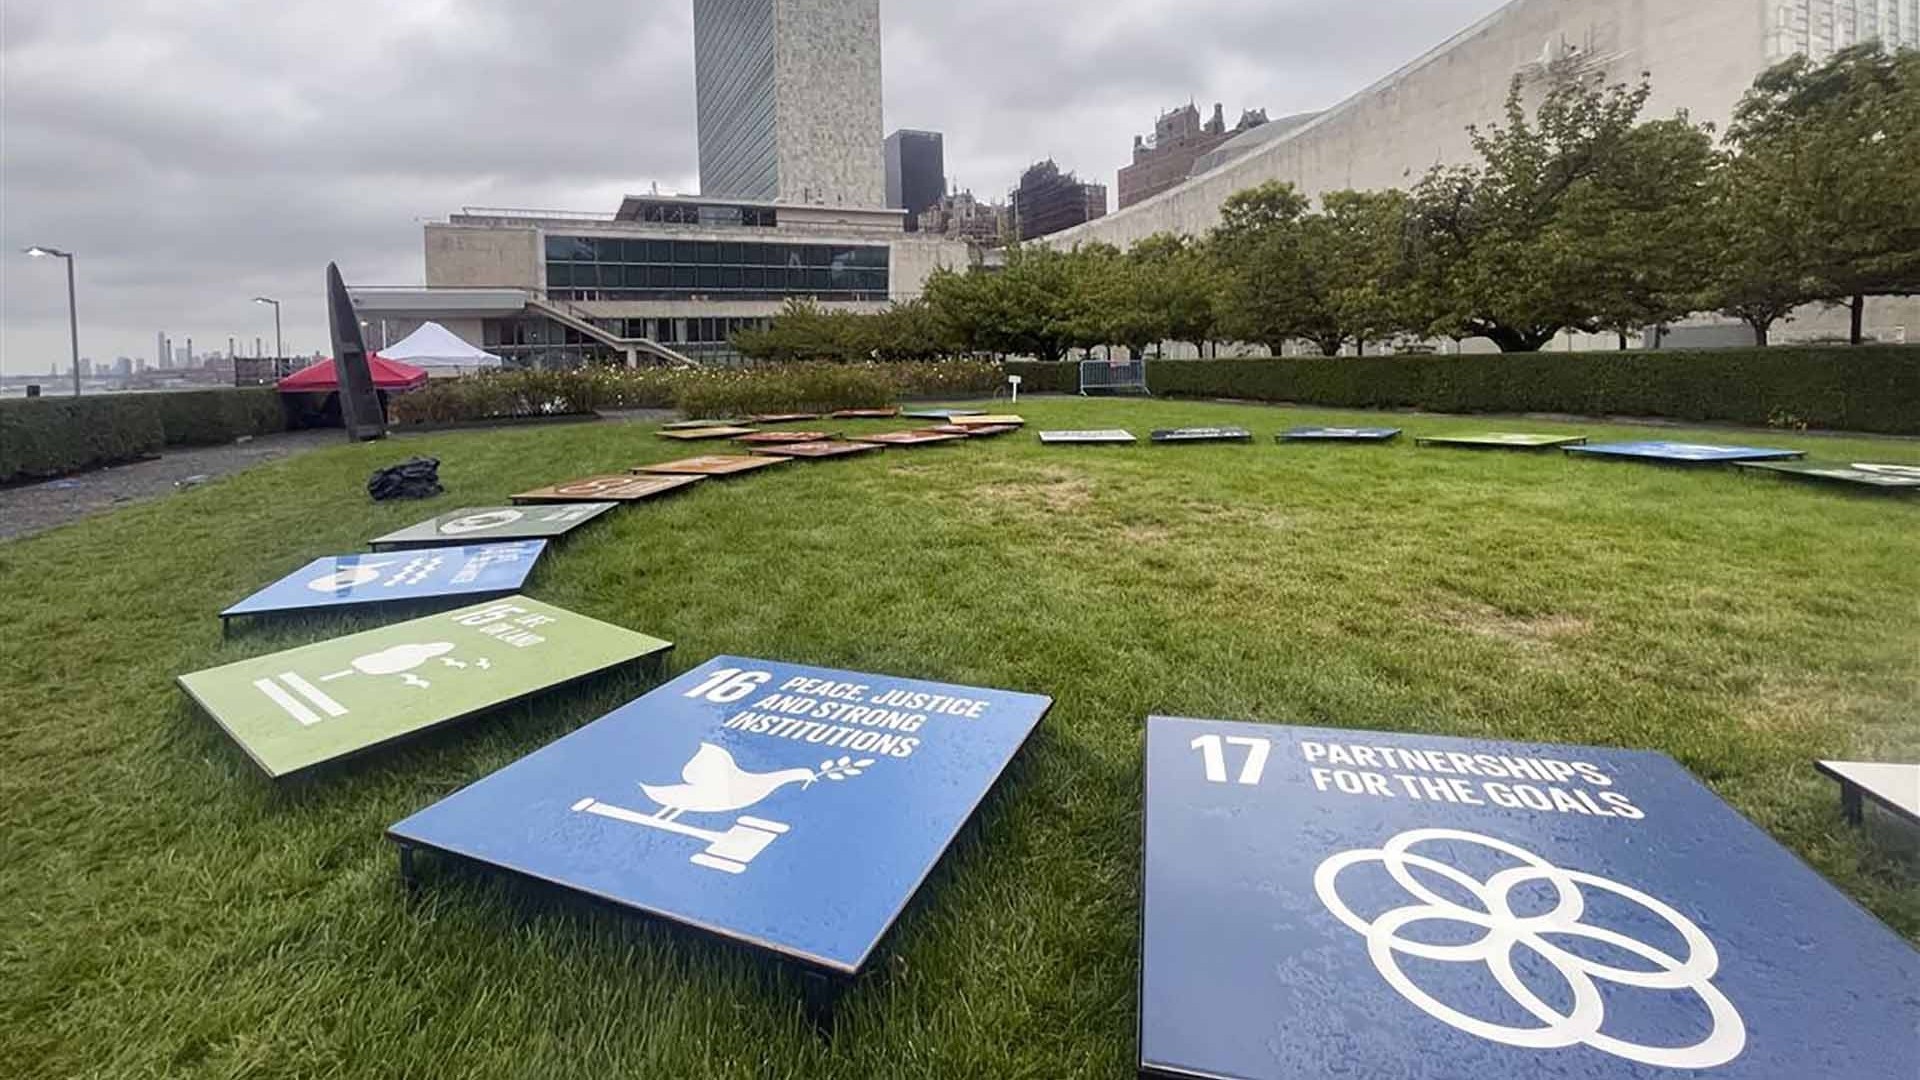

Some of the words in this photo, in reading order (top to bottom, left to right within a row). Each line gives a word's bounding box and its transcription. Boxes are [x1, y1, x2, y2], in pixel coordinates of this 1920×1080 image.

[451, 604, 526, 626] 15
[683, 667, 772, 703] 16
[779, 676, 869, 701] PEACE,
[871, 689, 990, 719] JUSTICE
[752, 694, 814, 716] AND
[811, 701, 927, 732] STRONG
[724, 711, 920, 758] INSTITUTIONS
[1191, 734, 1272, 786] 17
[1302, 741, 1614, 787] PARTNERSHIPS
[1311, 767, 1395, 797] FOR
[1397, 774, 1485, 805] THE
[1482, 782, 1646, 820] GOALS
